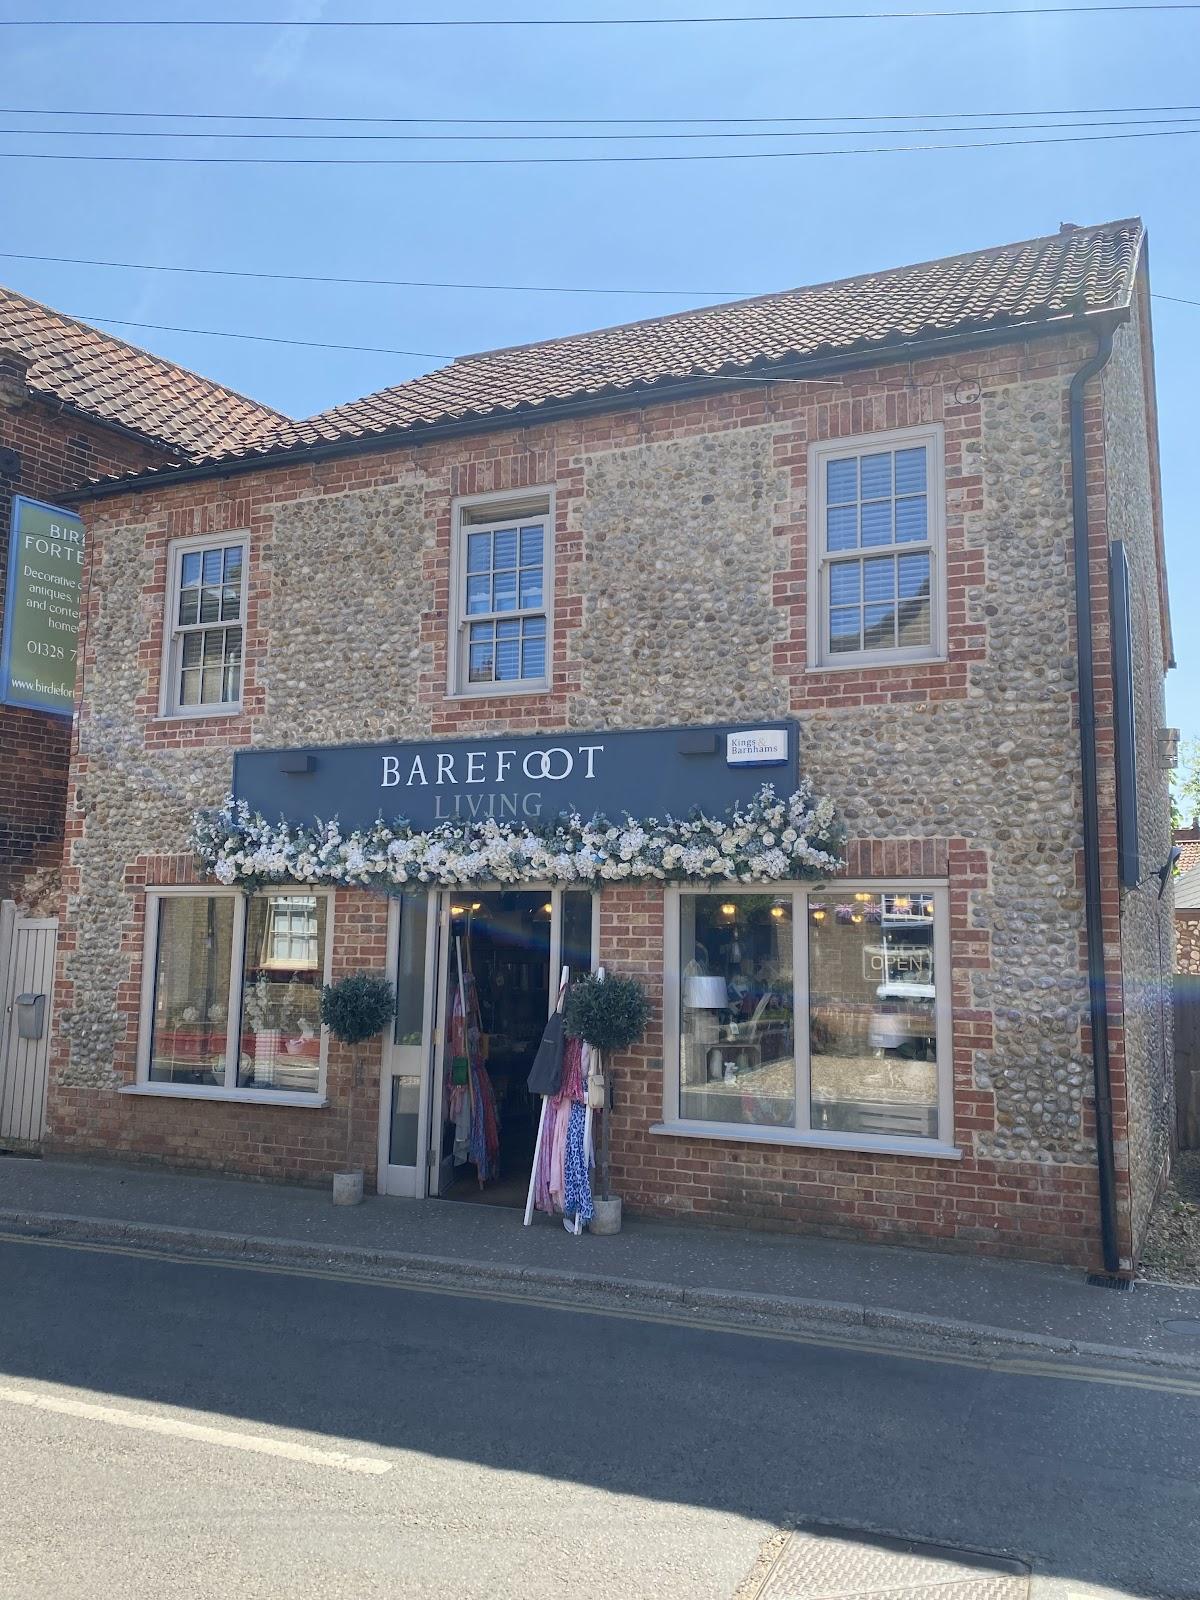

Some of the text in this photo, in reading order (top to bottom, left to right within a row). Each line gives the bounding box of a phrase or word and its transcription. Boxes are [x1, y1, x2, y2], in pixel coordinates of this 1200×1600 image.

[24, 565, 75, 588] Decorative
[26, 598, 47, 611] and
[27, 640, 64, 660] 01328
[731, 739, 756, 748] Kings
[731, 745, 778, 755] Barnhams
[380, 745, 604, 787] BAREFOOT
[434, 792, 542, 819] LIVING
[871, 956, 922, 971] OPEN
